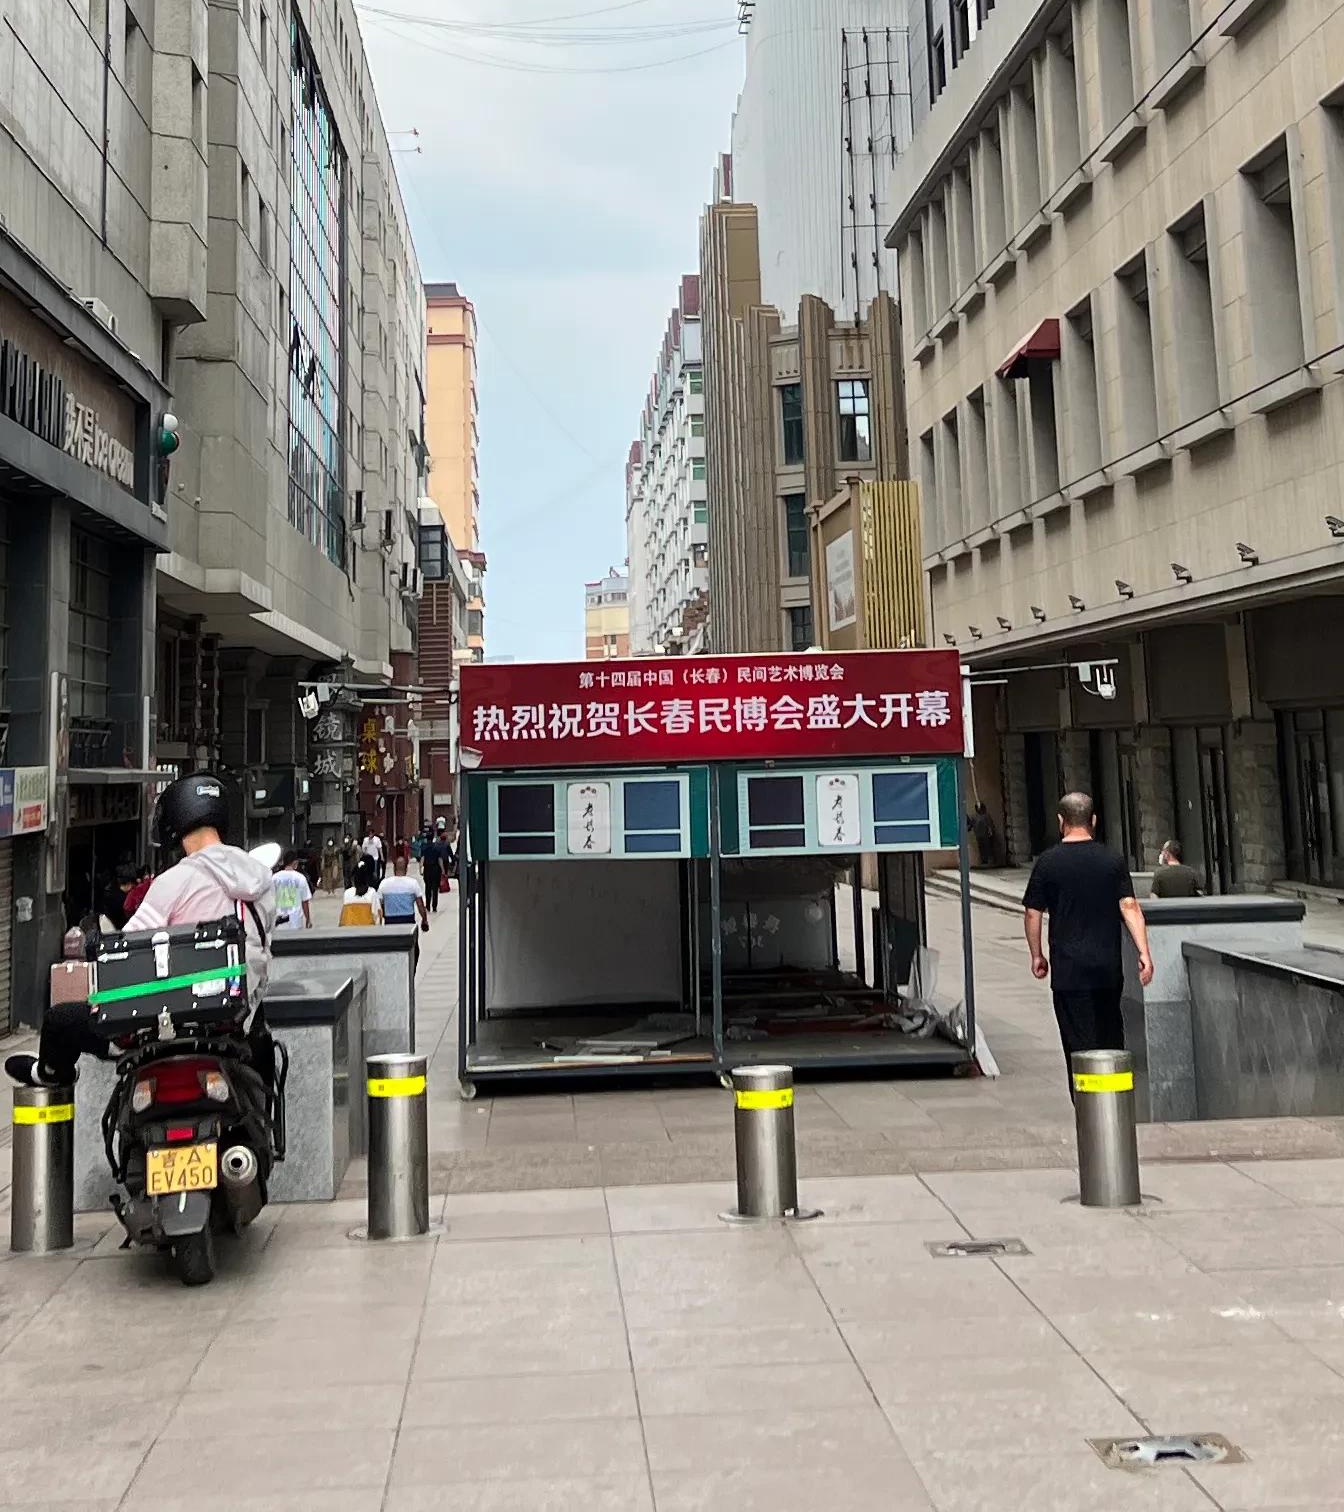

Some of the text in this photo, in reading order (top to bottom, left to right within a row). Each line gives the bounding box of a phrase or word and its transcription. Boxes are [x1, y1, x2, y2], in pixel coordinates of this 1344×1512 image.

[578, 662, 845, 689] 第十四届中国（长春）民间艺术博览会
[472, 690, 952, 742] 热烈祝贺长春民博会盛大开幕
[151, 1165, 214, 1192] EV450
